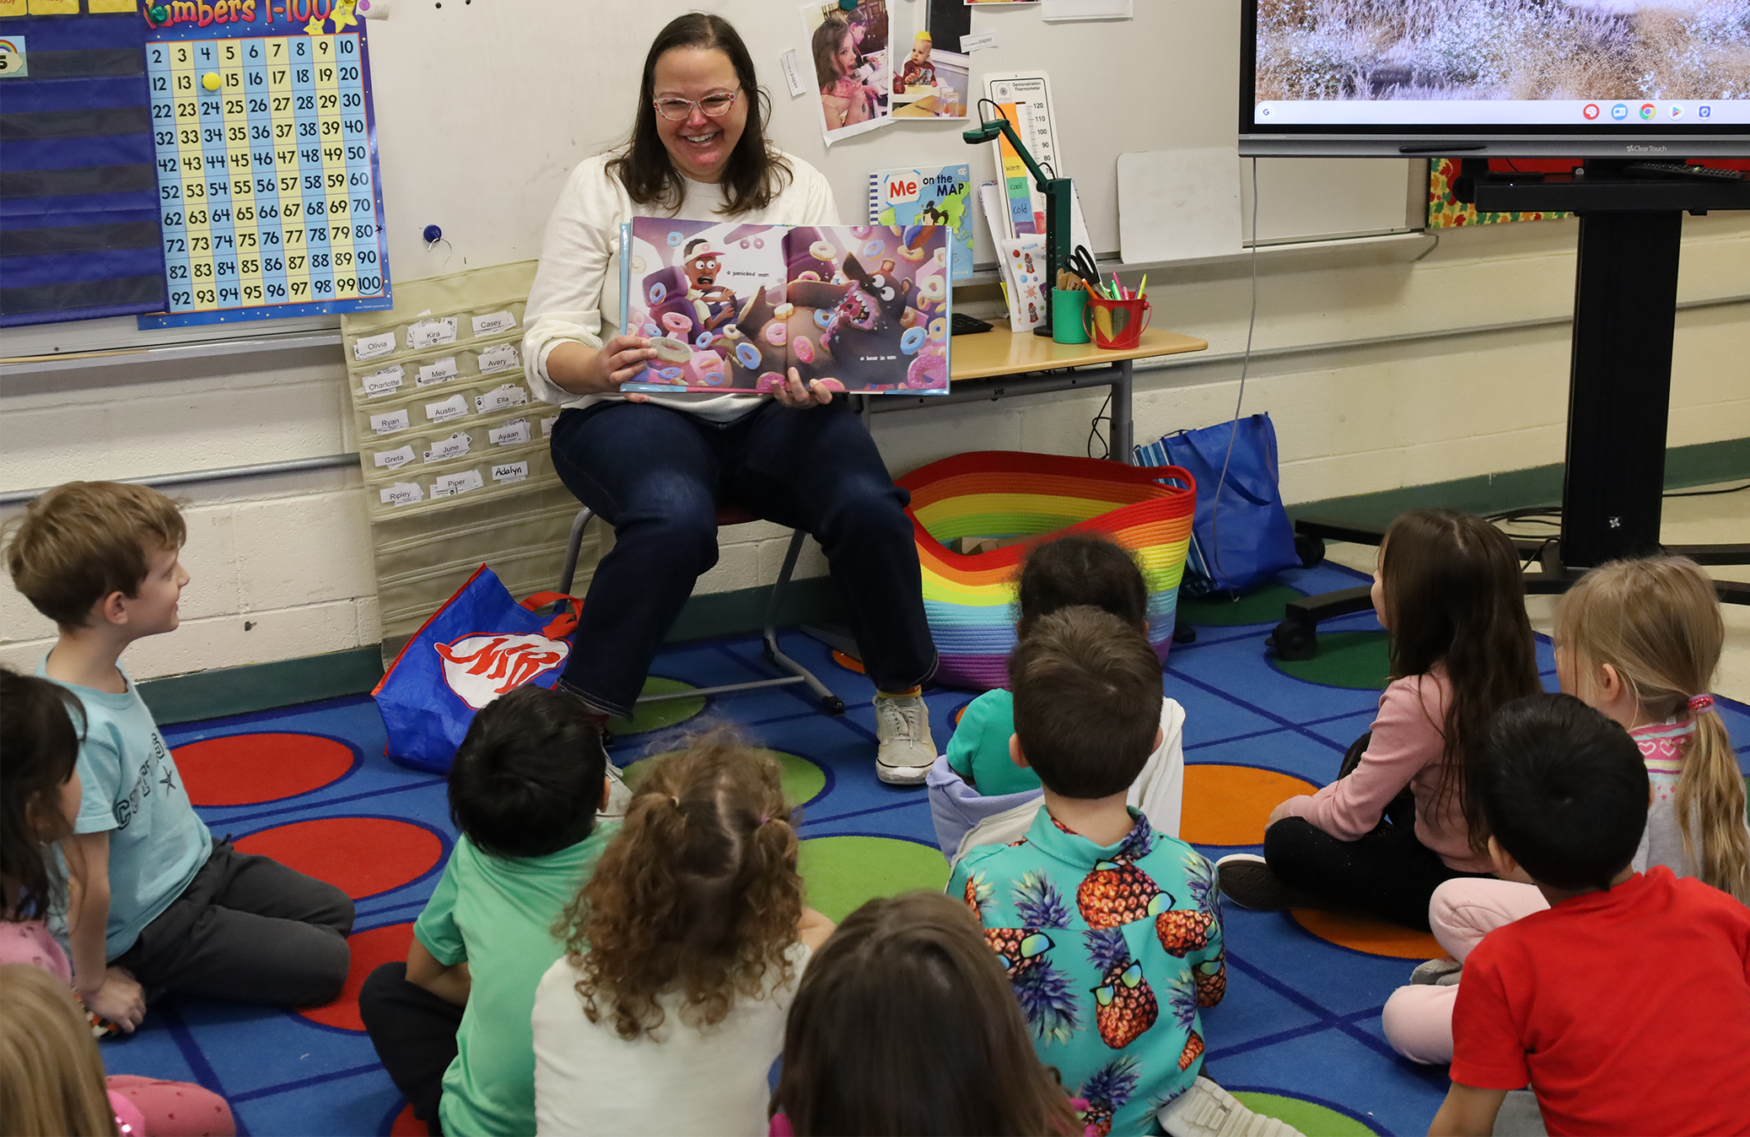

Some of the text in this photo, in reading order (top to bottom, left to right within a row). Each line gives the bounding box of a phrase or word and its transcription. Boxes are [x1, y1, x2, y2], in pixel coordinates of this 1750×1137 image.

[152, 40, 353, 64] 2 3 4 5 6 7 8 9 10
[153, 77, 167, 91] 12
[178, 76, 191, 89] 13
[226, 73, 239, 87] 15
[249, 72, 263, 85] 16
[273, 71, 286, 84] 17
[297, 69, 309, 83] 18
[319, 68, 332, 81] 19
[340, 67, 358, 80] 20
[153, 93, 361, 118] 22 23 24 25 26 27 28 29 30
[155, 120, 363, 146] 32 33 34 35 36 37 38 39 40
[158, 146, 365, 173] 42 43 44 45 46 47 48 49 50
[922, 174, 953, 185] on the
[162, 172, 369, 200] 52 53 54 55 56 57 58 59 60
[890, 180, 917, 198] Me
[936, 183, 965, 197] MAP
[1010, 181, 1023, 190] cool
[164, 199, 370, 226] 62 63 64 65 66 67 68 69 70
[1012, 204, 1028, 214] cold
[166, 225, 372, 253] 72 73 74 75 76 77 78 79 80
[169, 250, 376, 279] 82 83 84 85 86 87 88 89 90
[172, 276, 381, 305] 92 93 94 95 96 97 98 99 100
[480, 320, 502, 329] Casey
[426, 331, 441, 339] Kira
[368, 341, 388, 350] Olivia
[488, 358, 507, 367] Avery
[431, 370, 447, 378] Meir
[369, 380, 400, 391] Charlotte
[435, 406, 456, 416] Austin
[381, 418, 400, 428] Ryan
[498, 431, 519, 441] Ayaan
[443, 444, 459, 453] June
[384, 455, 404, 464] Greta
[495, 465, 522, 476] Adalyn
[447, 479, 466, 488] Piper
[390, 491, 411, 500] Ripley
